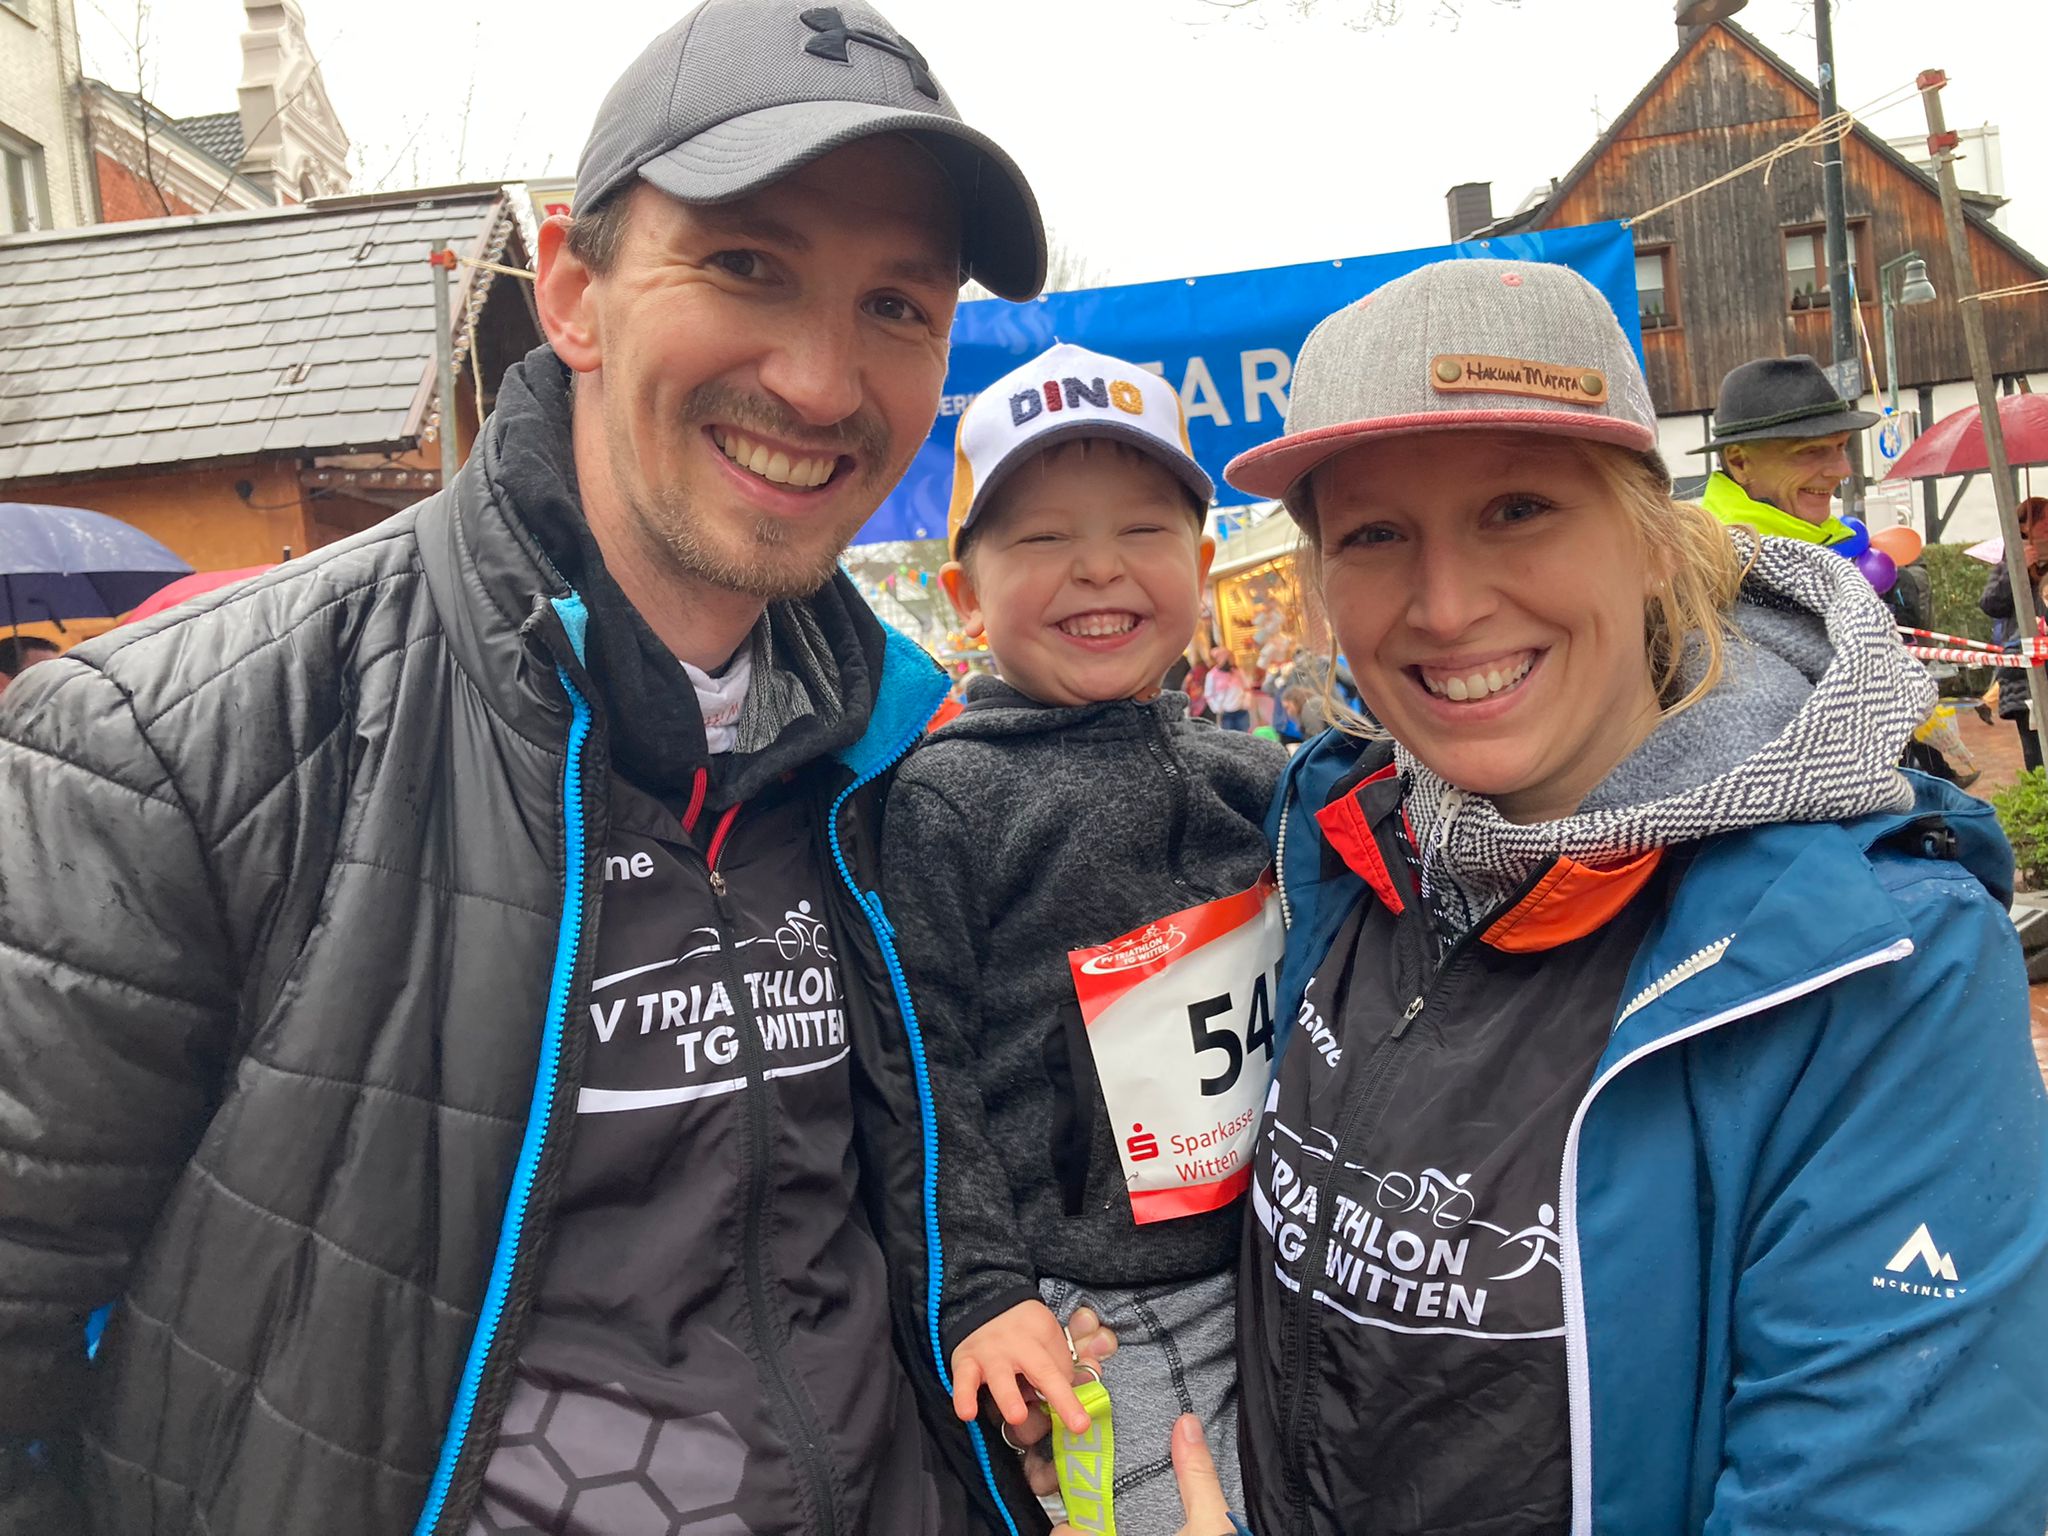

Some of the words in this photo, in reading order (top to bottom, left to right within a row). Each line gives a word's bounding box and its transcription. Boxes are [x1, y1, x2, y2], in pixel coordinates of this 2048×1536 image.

[940, 393, 974, 416] ER
[1008, 377, 1144, 427] DINO
[605, 852, 654, 881] ne
[1115, 937, 1163, 960] TRIATHLON
[1138, 943, 1170, 961] WITTEN
[590, 999, 625, 1042] V
[1187, 953, 1285, 1097] 54
[676, 1025, 739, 1073] TG
[1170, 1107, 1254, 1157] Sparkasse
[1175, 1149, 1240, 1182] Witten
[1325, 1238, 1487, 1326] WITTEN
